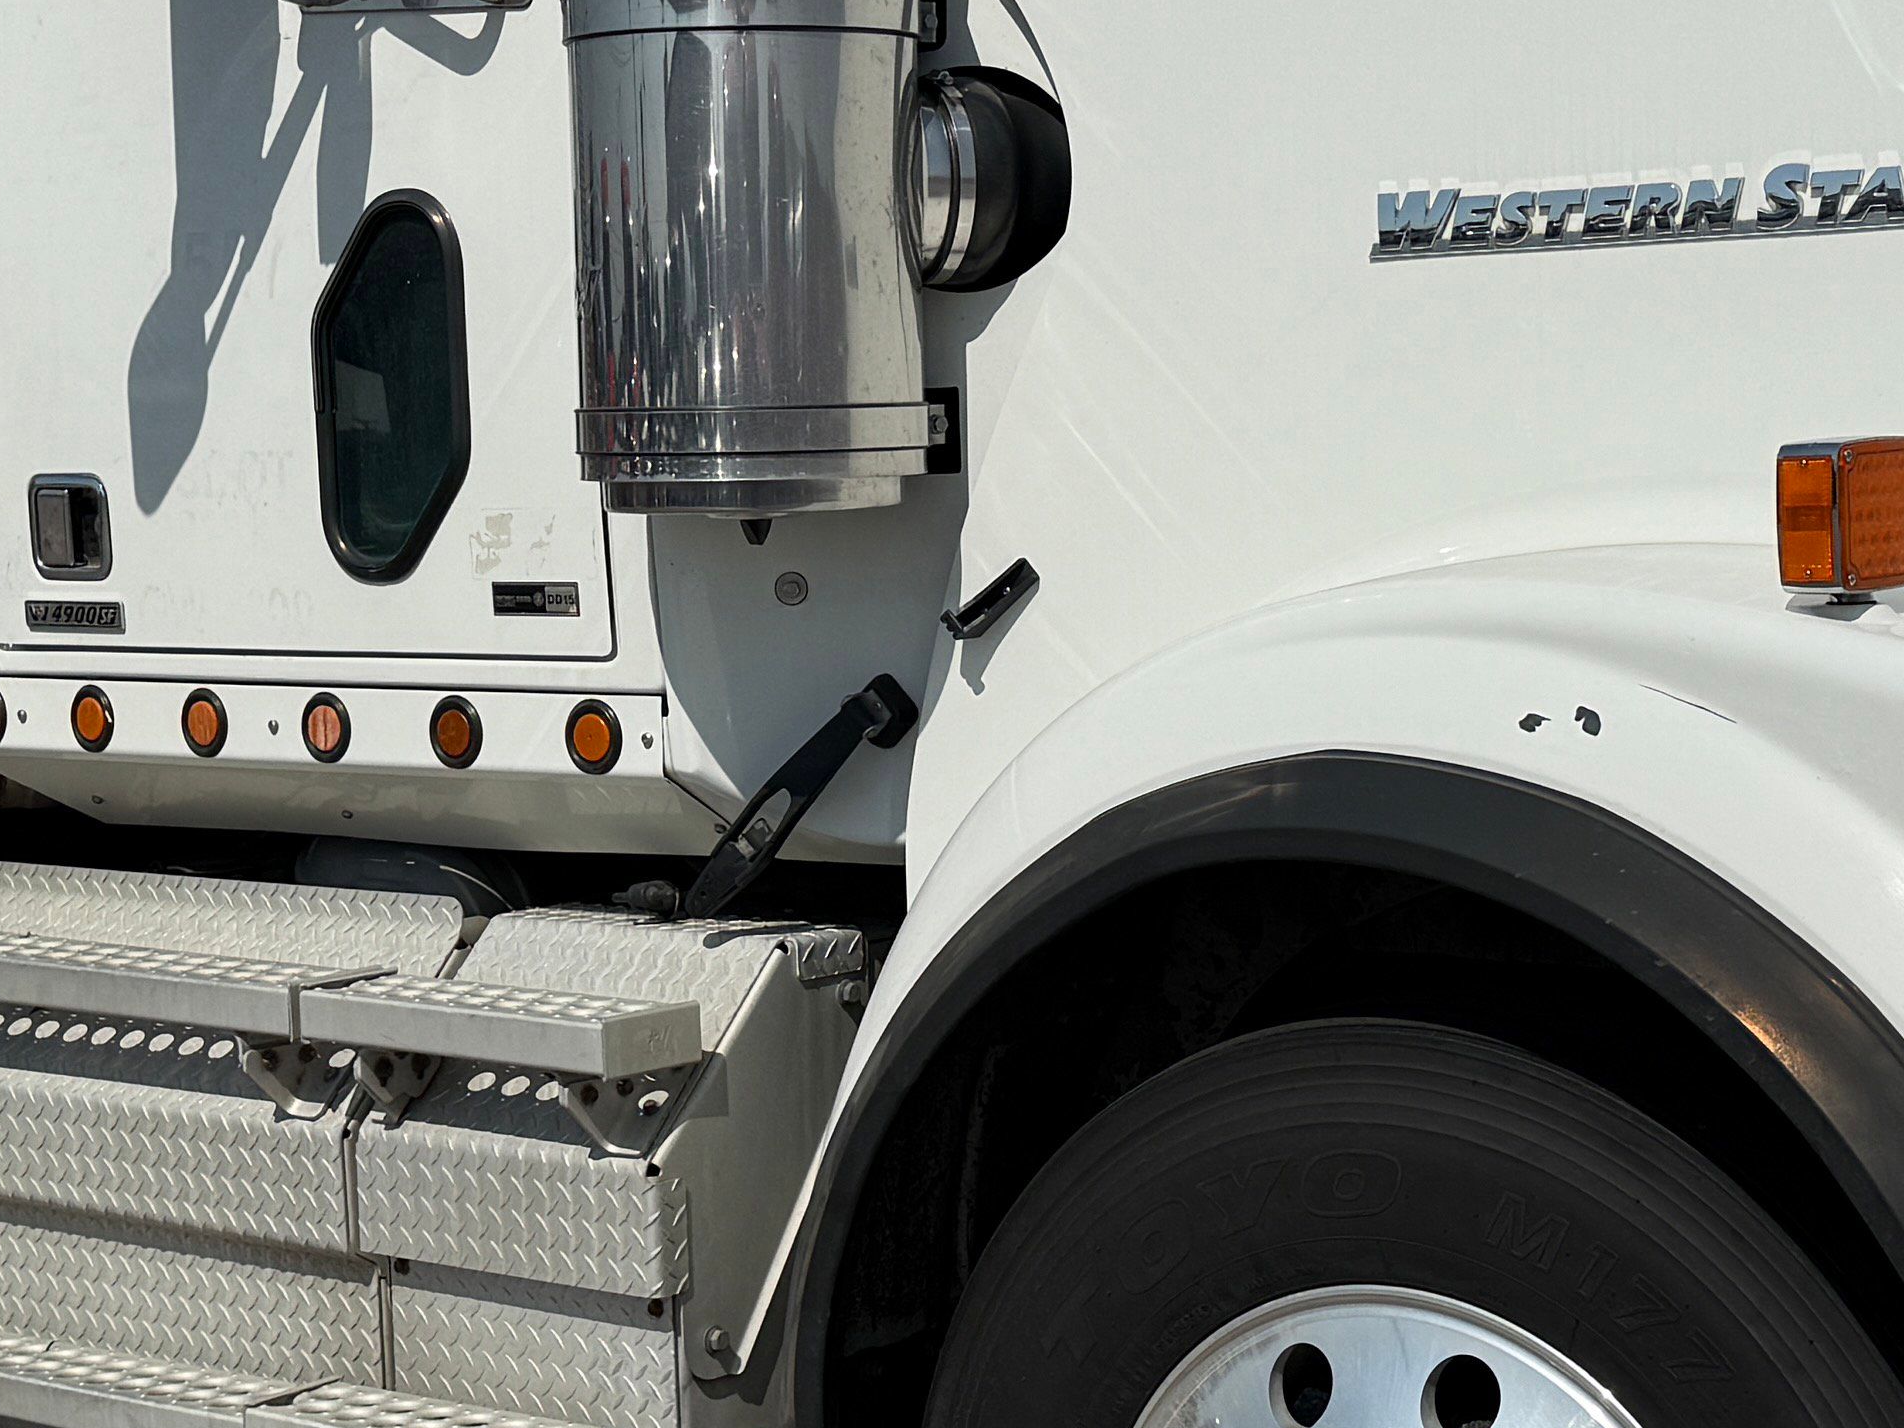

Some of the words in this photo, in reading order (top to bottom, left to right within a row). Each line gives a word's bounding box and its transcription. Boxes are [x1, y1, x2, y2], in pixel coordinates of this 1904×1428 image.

[1376, 175, 1746, 252] WESTERN
[1041, 1147, 1403, 1367] TOYO
[1482, 1190, 1738, 1384] M177
